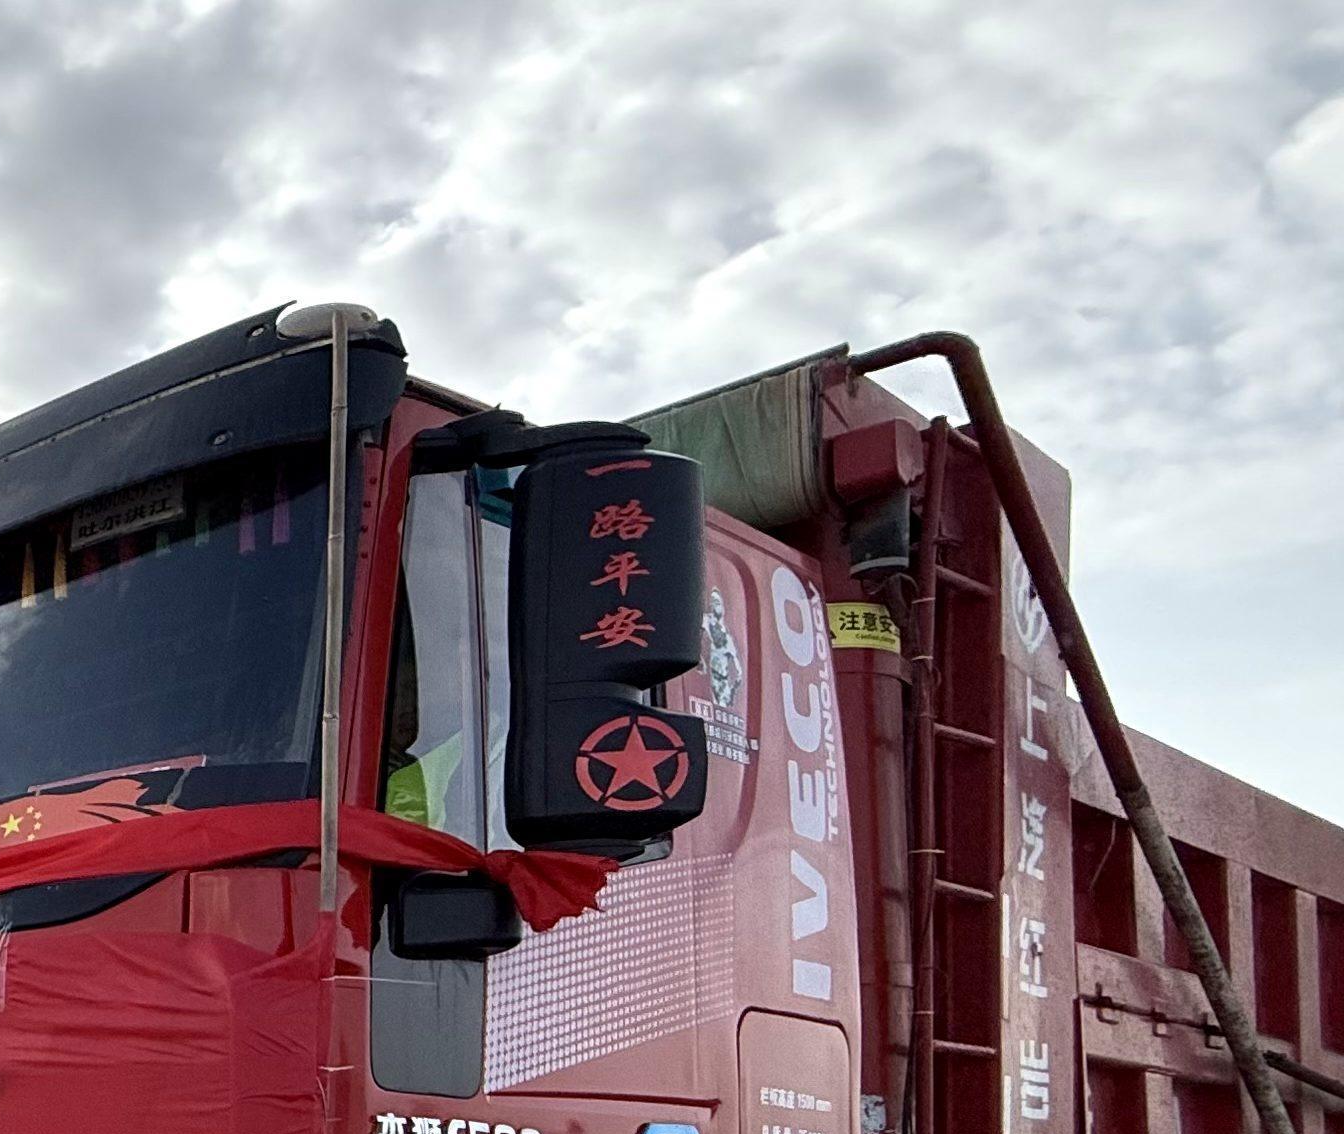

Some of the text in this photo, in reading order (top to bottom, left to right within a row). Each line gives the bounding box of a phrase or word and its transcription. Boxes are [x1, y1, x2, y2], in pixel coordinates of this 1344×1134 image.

[580, 459, 656, 649] 一路平安
[838, 611, 900, 637] 注意安
[771, 564, 832, 1000] IVECO
[808, 579, 839, 842] TECHNOLOGY
